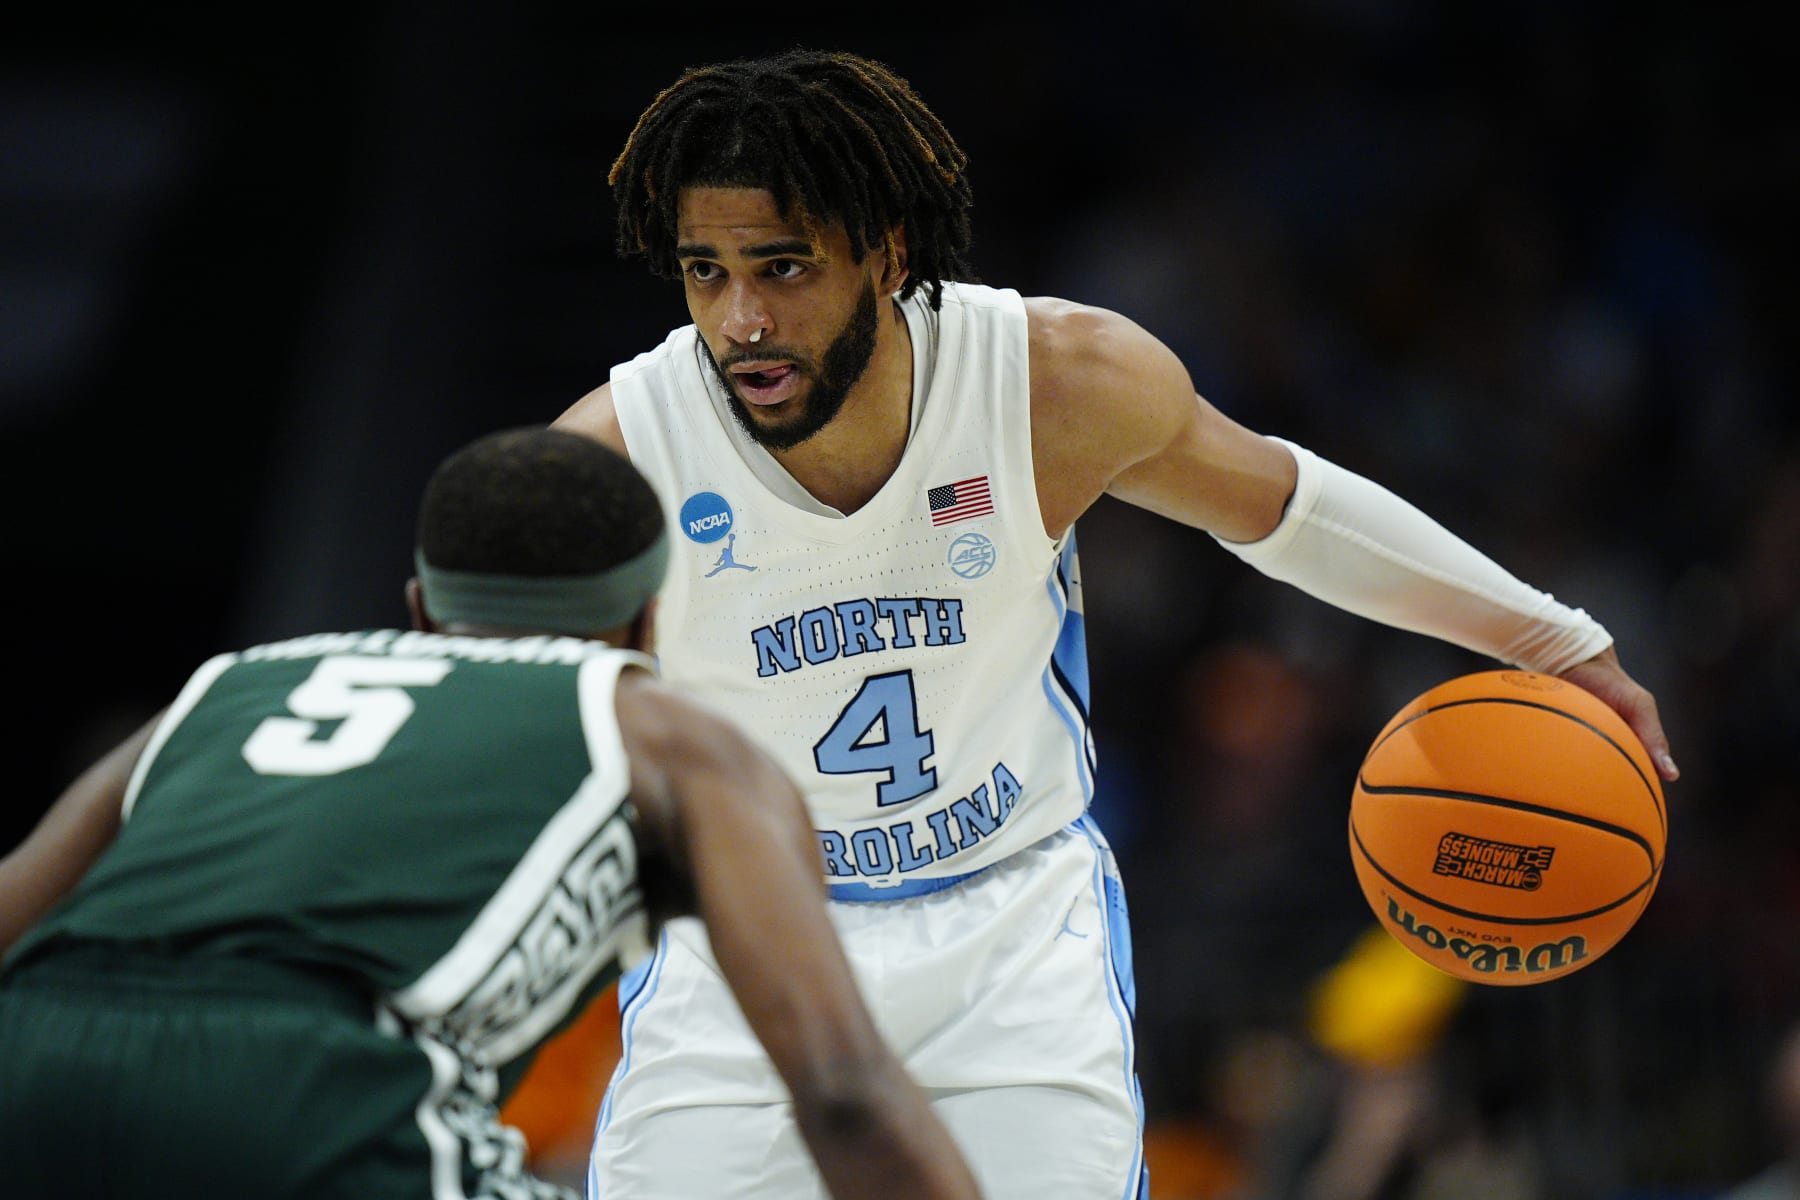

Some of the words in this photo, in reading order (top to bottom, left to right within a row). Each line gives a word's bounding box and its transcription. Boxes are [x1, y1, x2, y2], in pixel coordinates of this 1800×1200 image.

[689, 511, 730, 535] NCAA
[954, 545, 992, 562] ACC
[751, 596, 966, 677] NORTH
[241, 655, 456, 776] 5
[812, 668, 938, 807] 4
[817, 761, 1024, 878] ROLINA
[1440, 837, 1520, 869] MADNESS
[1462, 861, 1524, 887] MARCH
[1386, 895, 1589, 974] Wilson
[1447, 926, 1478, 940] NXT
[1481, 935, 1513, 944] EVO
